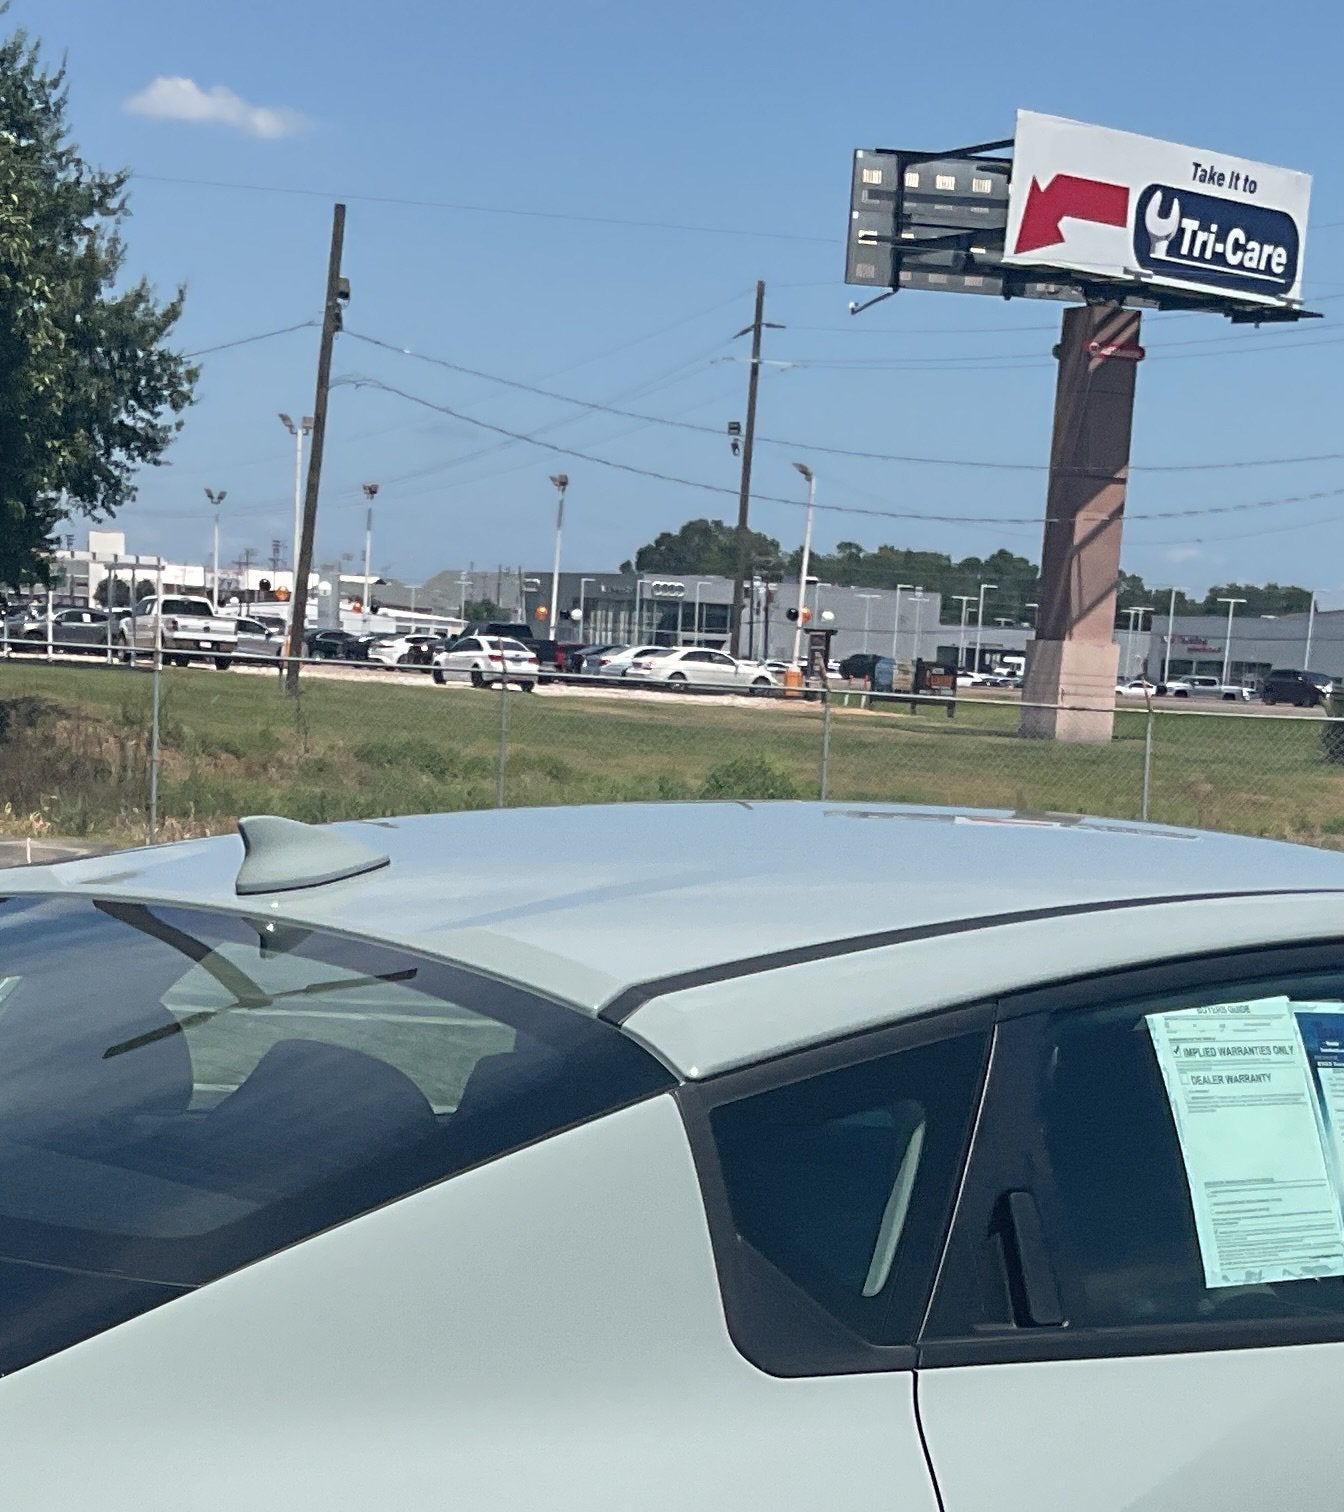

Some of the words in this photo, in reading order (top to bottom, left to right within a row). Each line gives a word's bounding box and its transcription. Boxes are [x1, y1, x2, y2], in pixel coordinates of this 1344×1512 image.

[1192, 161, 1225, 187] Take
[1242, 174, 1258, 194] to
[1180, 217, 1288, 275] Tri-Care
[1183, 1047, 1216, 1058] IMPLIED
[1218, 1045, 1271, 1057] WARRANTIES
[1273, 1045, 1294, 1056] ONLY
[1191, 1074, 1224, 1085] DEALER
[1225, 1073, 1272, 1084] WARRANTY
